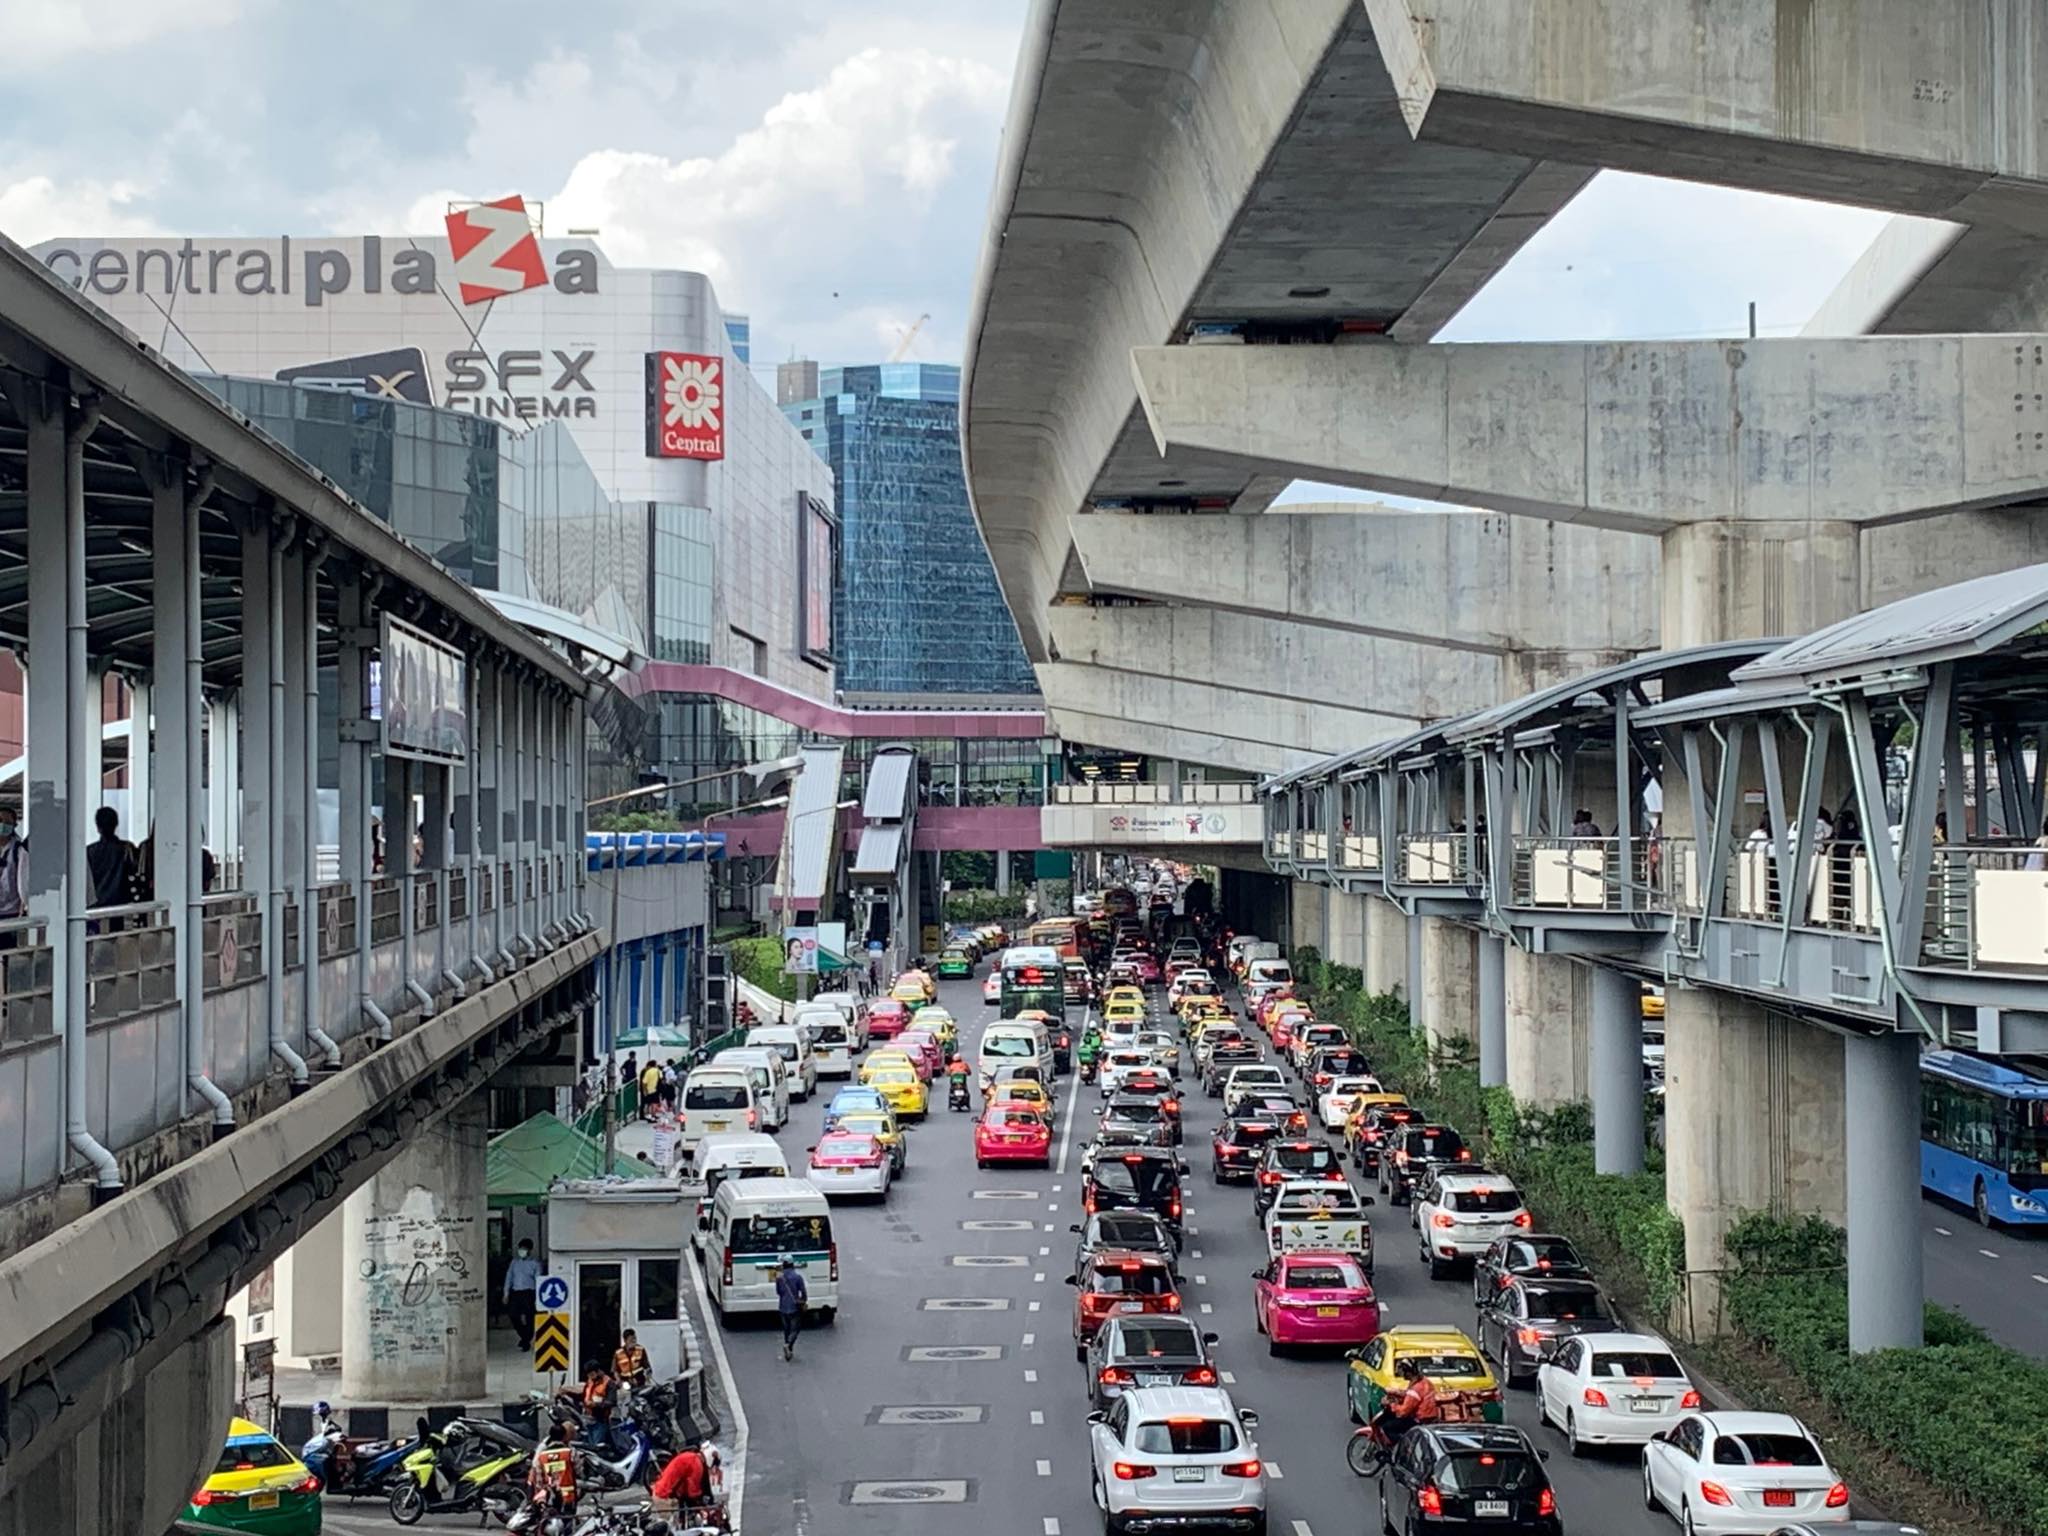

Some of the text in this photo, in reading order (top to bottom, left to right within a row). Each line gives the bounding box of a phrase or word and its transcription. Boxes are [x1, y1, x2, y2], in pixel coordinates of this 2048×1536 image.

[445, 350, 596, 391] SFX
[447, 397, 597, 418] CINEMA
[664, 432, 721, 455] Central
